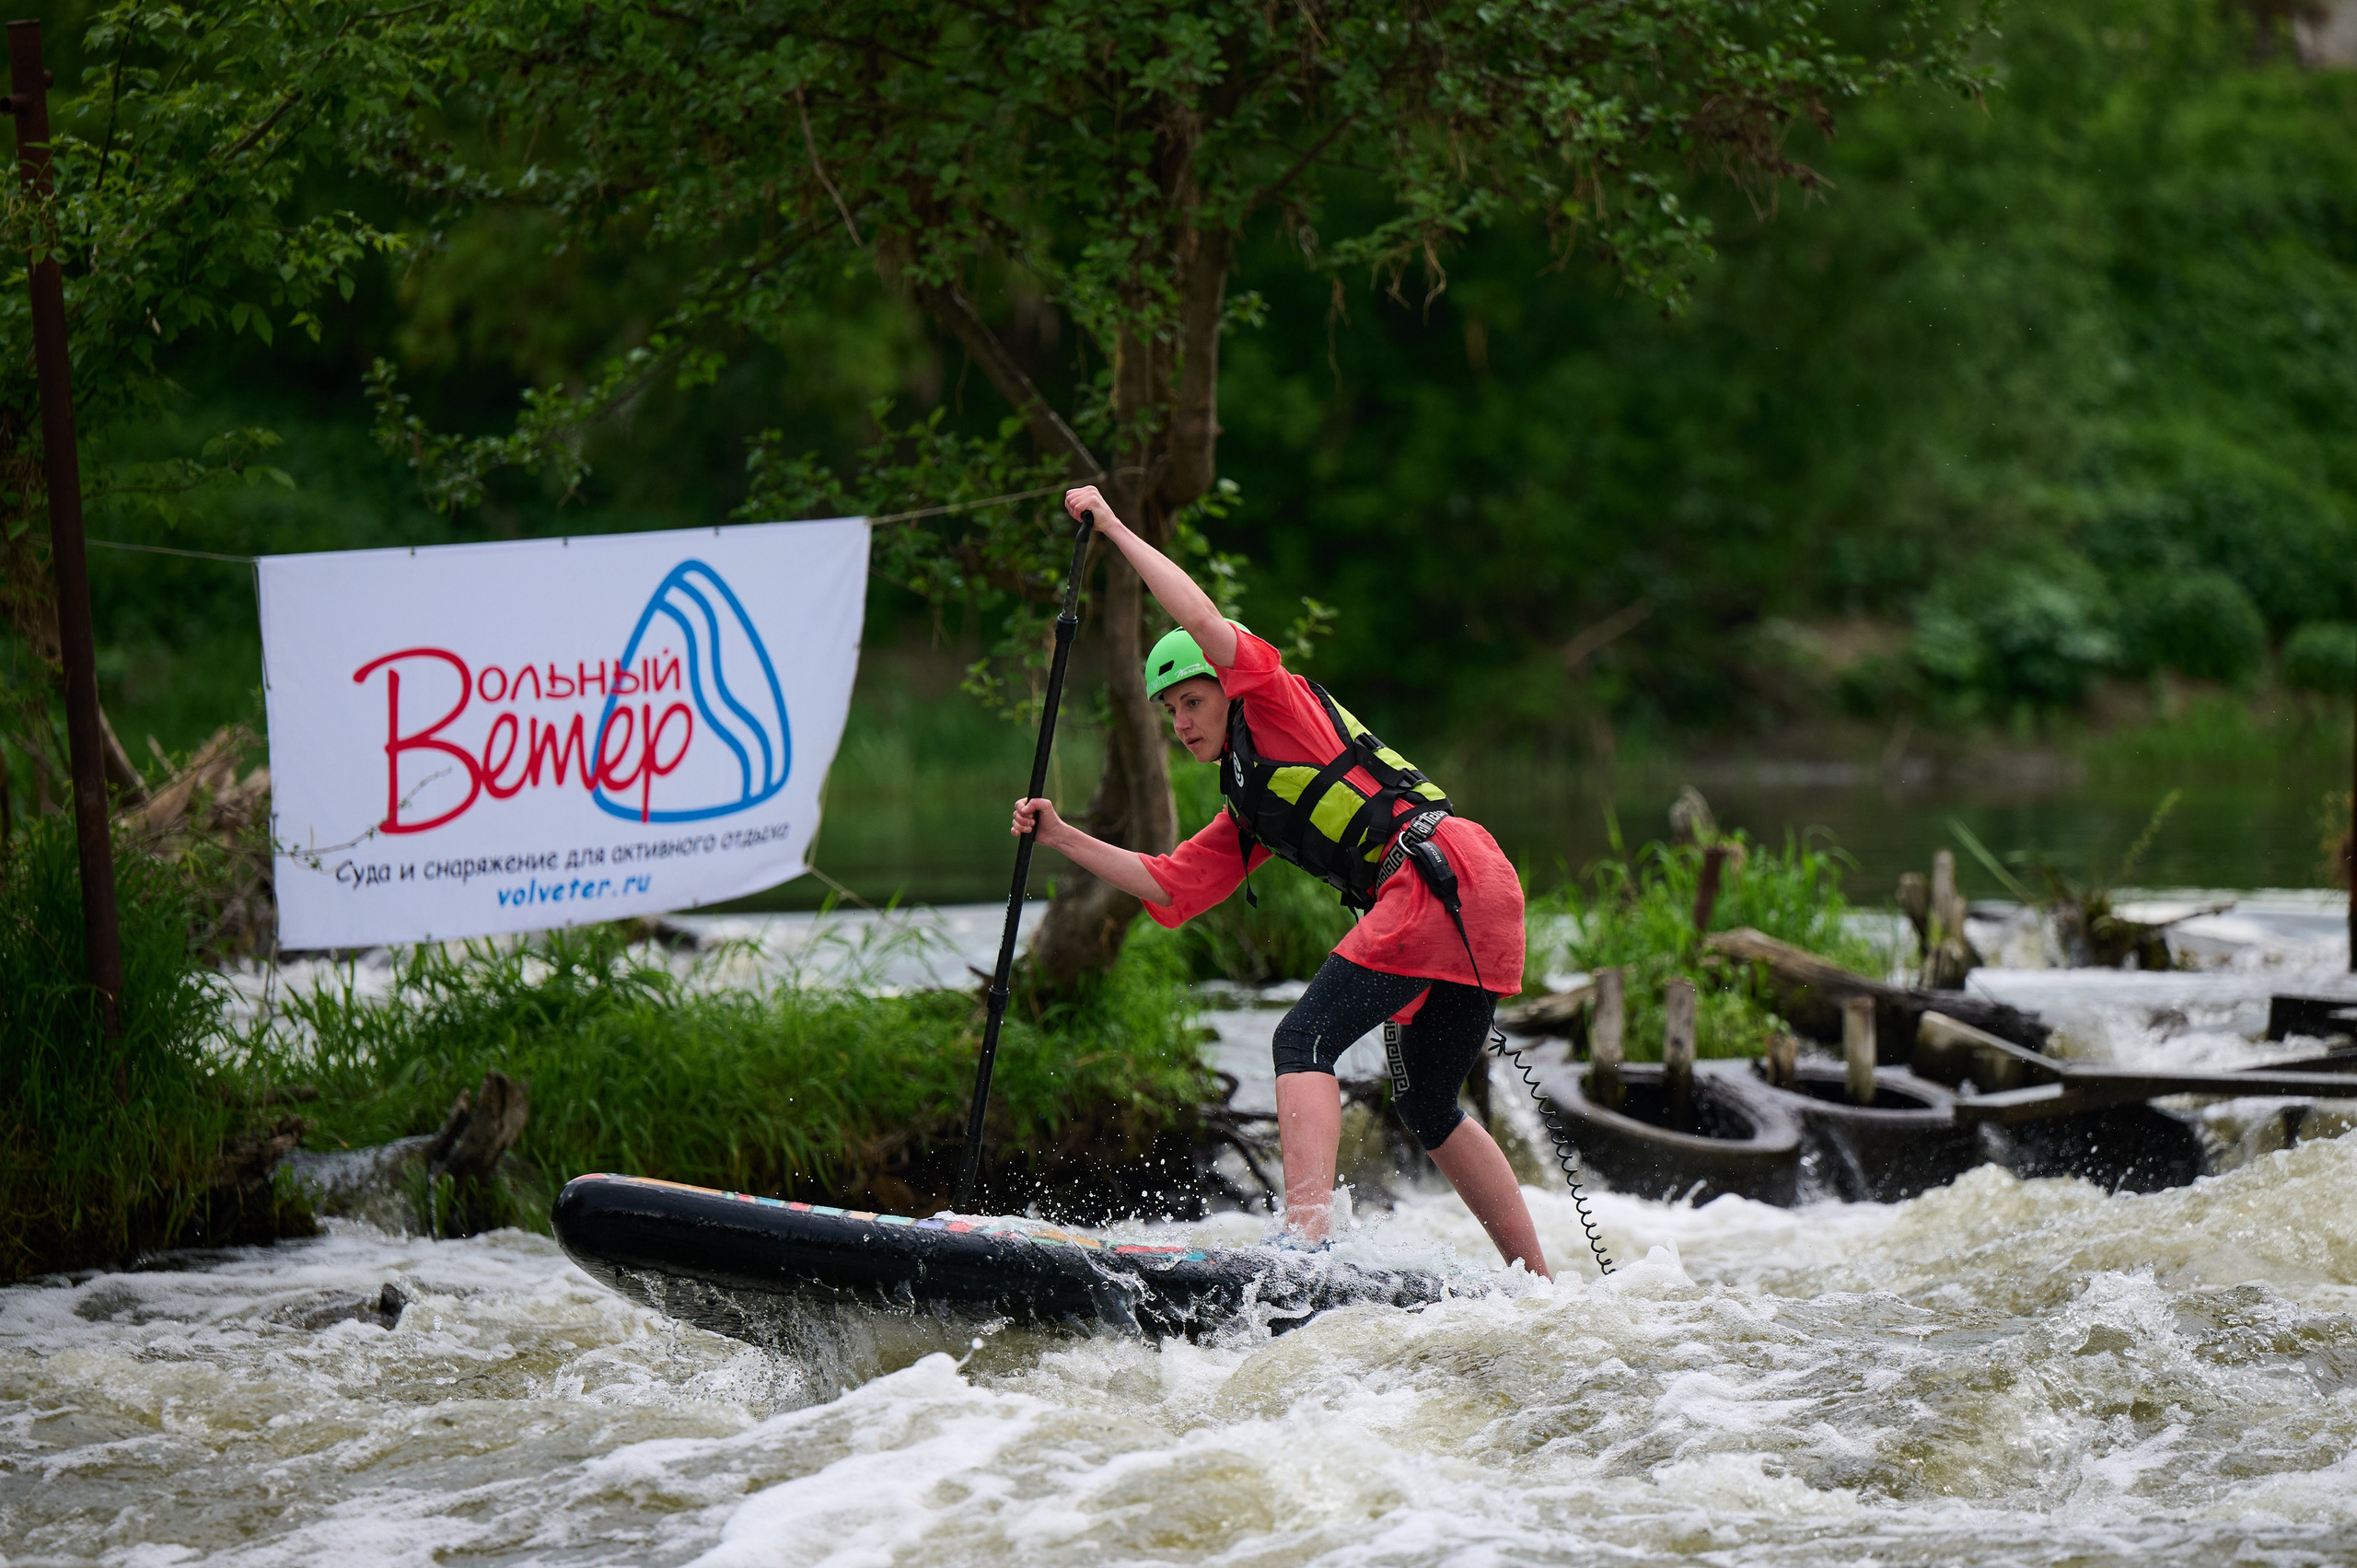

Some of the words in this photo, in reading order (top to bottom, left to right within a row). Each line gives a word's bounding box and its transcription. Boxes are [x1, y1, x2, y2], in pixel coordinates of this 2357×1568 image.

[354, 647, 693, 834] Ветер
[335, 860, 391, 891] Суда
[399, 861, 414, 881] и
[423, 851, 558, 886] снаряжение
[564, 846, 606, 871] для
[611, 833, 715, 865] активного
[719, 822, 790, 850] отдыха
[497, 872, 653, 908] volveter.ru
